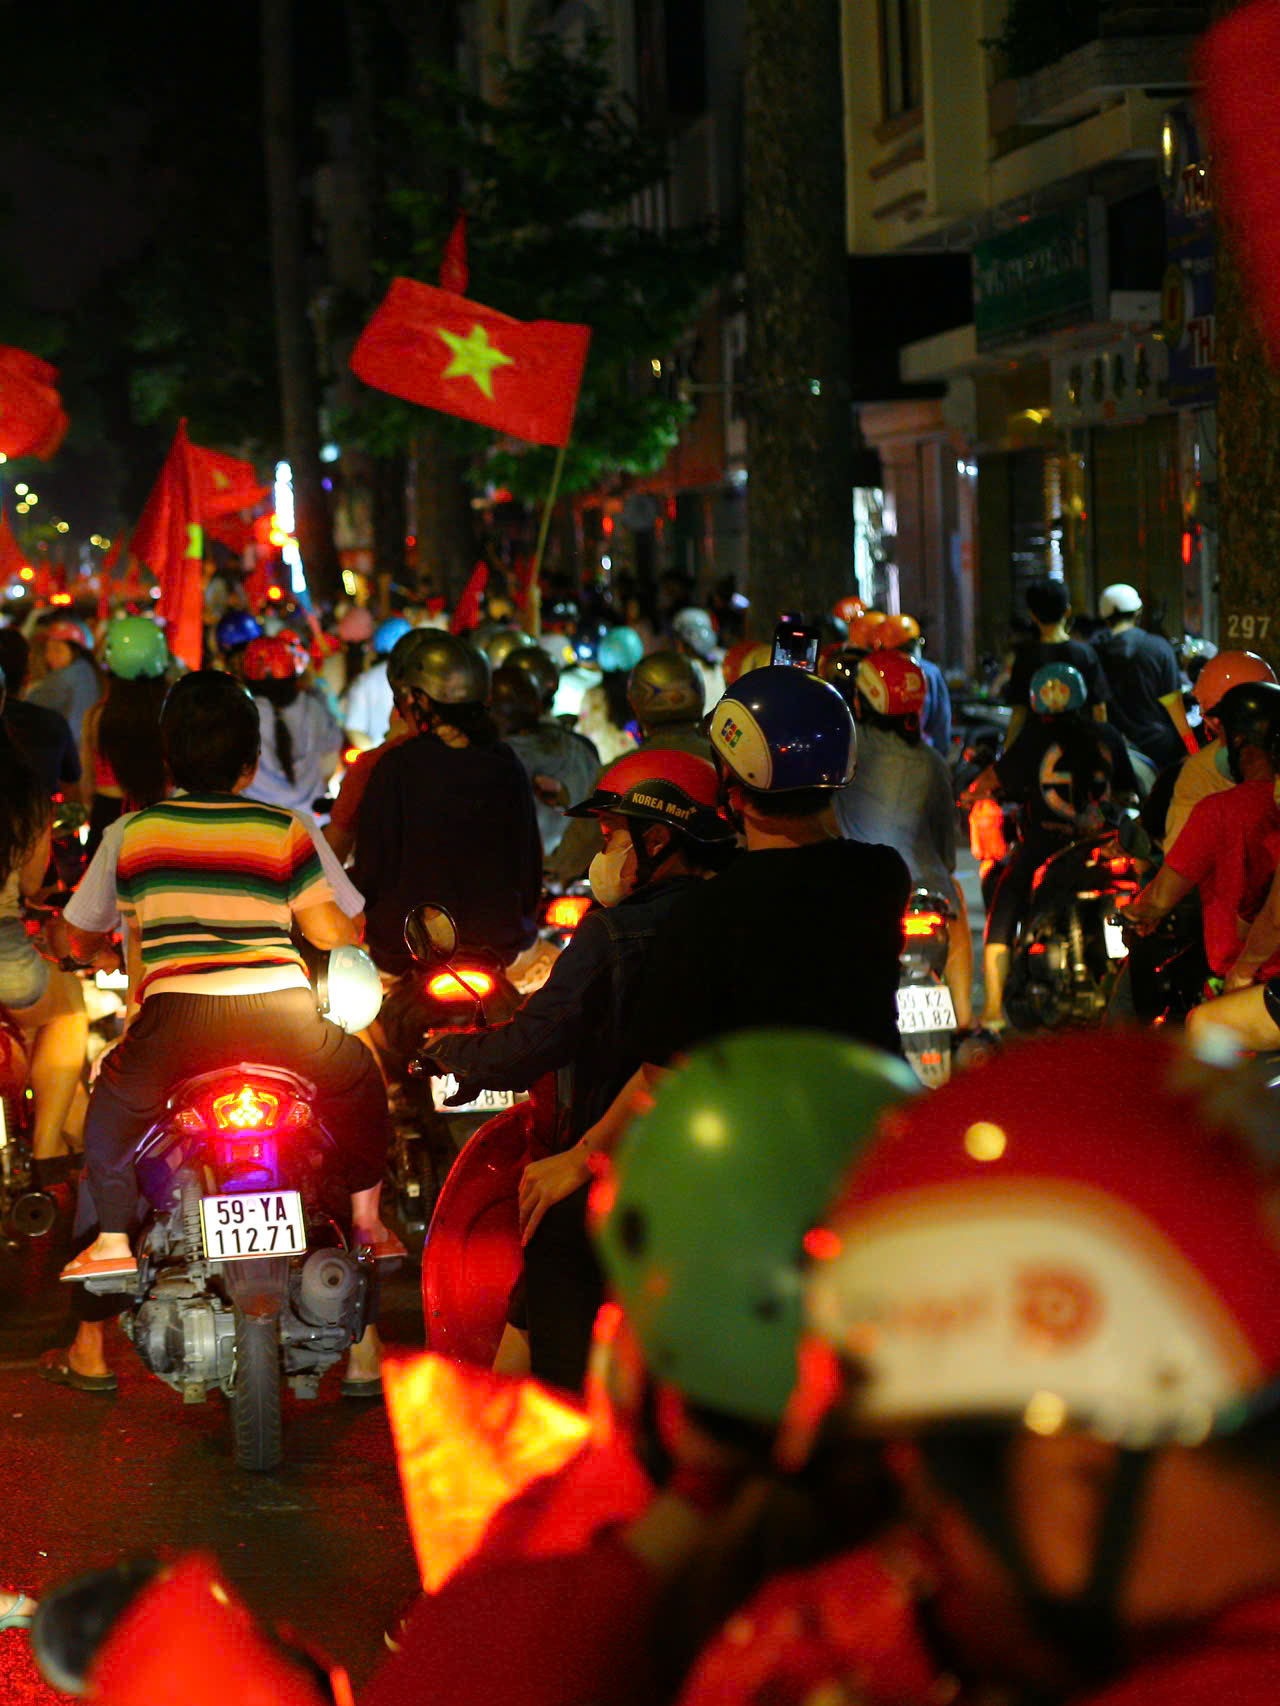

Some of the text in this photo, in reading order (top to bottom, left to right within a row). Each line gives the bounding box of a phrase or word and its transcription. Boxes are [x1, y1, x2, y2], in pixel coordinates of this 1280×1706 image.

[1228, 614, 1271, 639] 297
[632, 792, 664, 811] KOREA
[216, 1196, 288, 1225] 59-YA
[215, 1224, 296, 1255] 112.71
